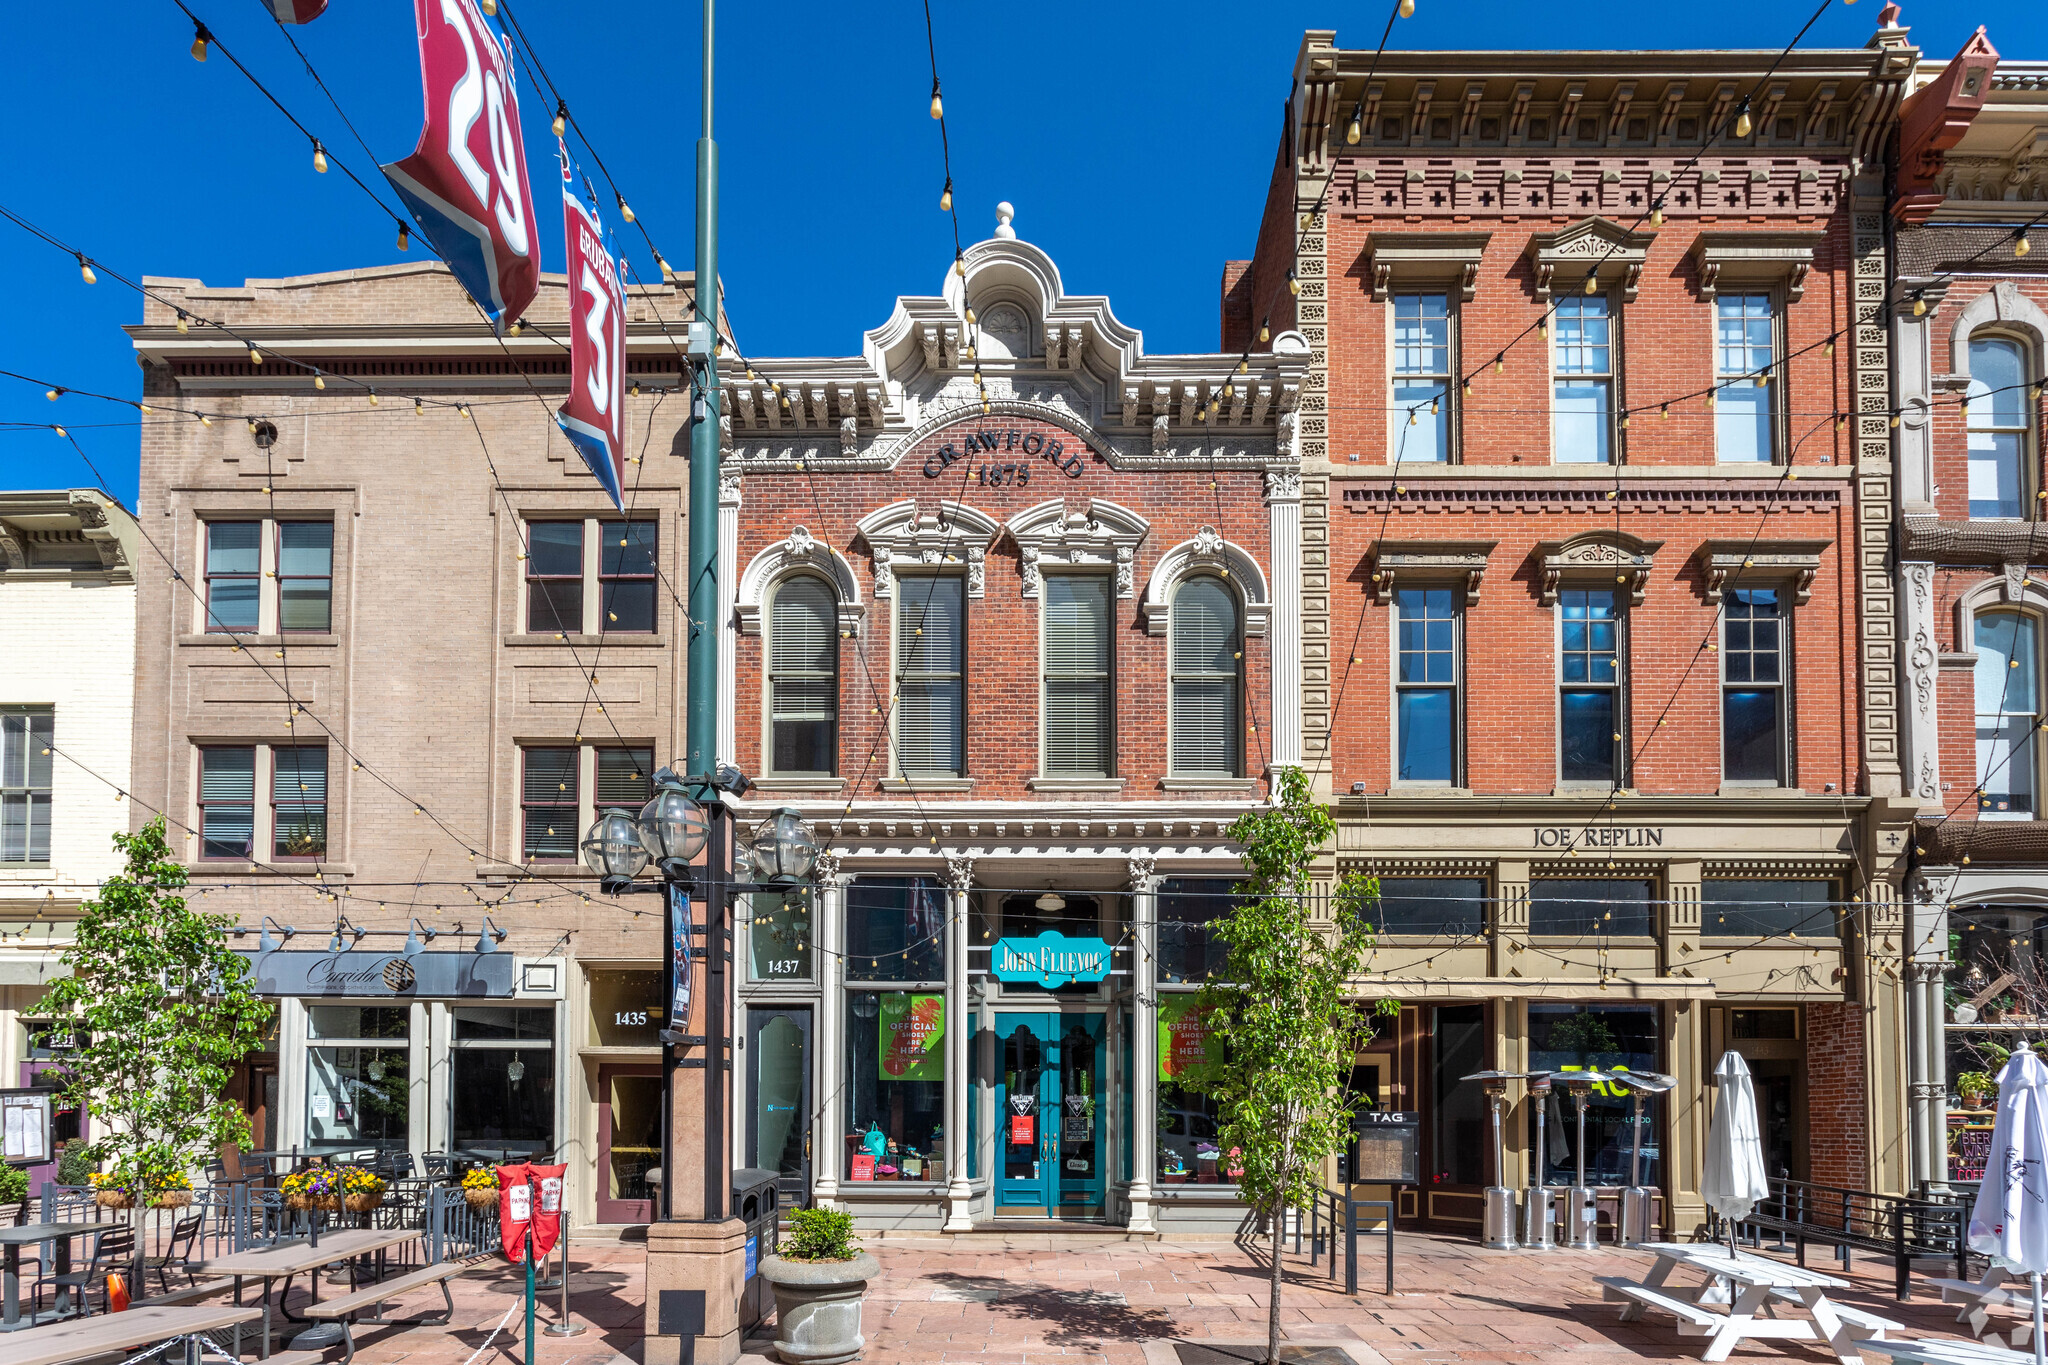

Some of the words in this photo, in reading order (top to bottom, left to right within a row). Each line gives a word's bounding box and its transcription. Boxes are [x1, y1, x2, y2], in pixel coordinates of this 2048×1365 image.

[581, 260, 620, 442] 31
[923, 428, 1085, 479] CRAWFORD
[977, 463, 1031, 487] 1875
[1533, 828, 1571, 848] JOE
[1585, 828, 1664, 847] REPLIN
[768, 960, 799, 973] 1437
[1041, 947, 1103, 973] FLUEVOG
[307, 956, 399, 984] Corridor
[615, 1012, 647, 1026] 1435
[1370, 1112, 1404, 1122] TAG
[1631, 1116, 1651, 1124] FOD
[1961, 1131, 1991, 1145] BEER
[1963, 1144, 1991, 1157] WINE
[1957, 1169, 1986, 1181] COFF
